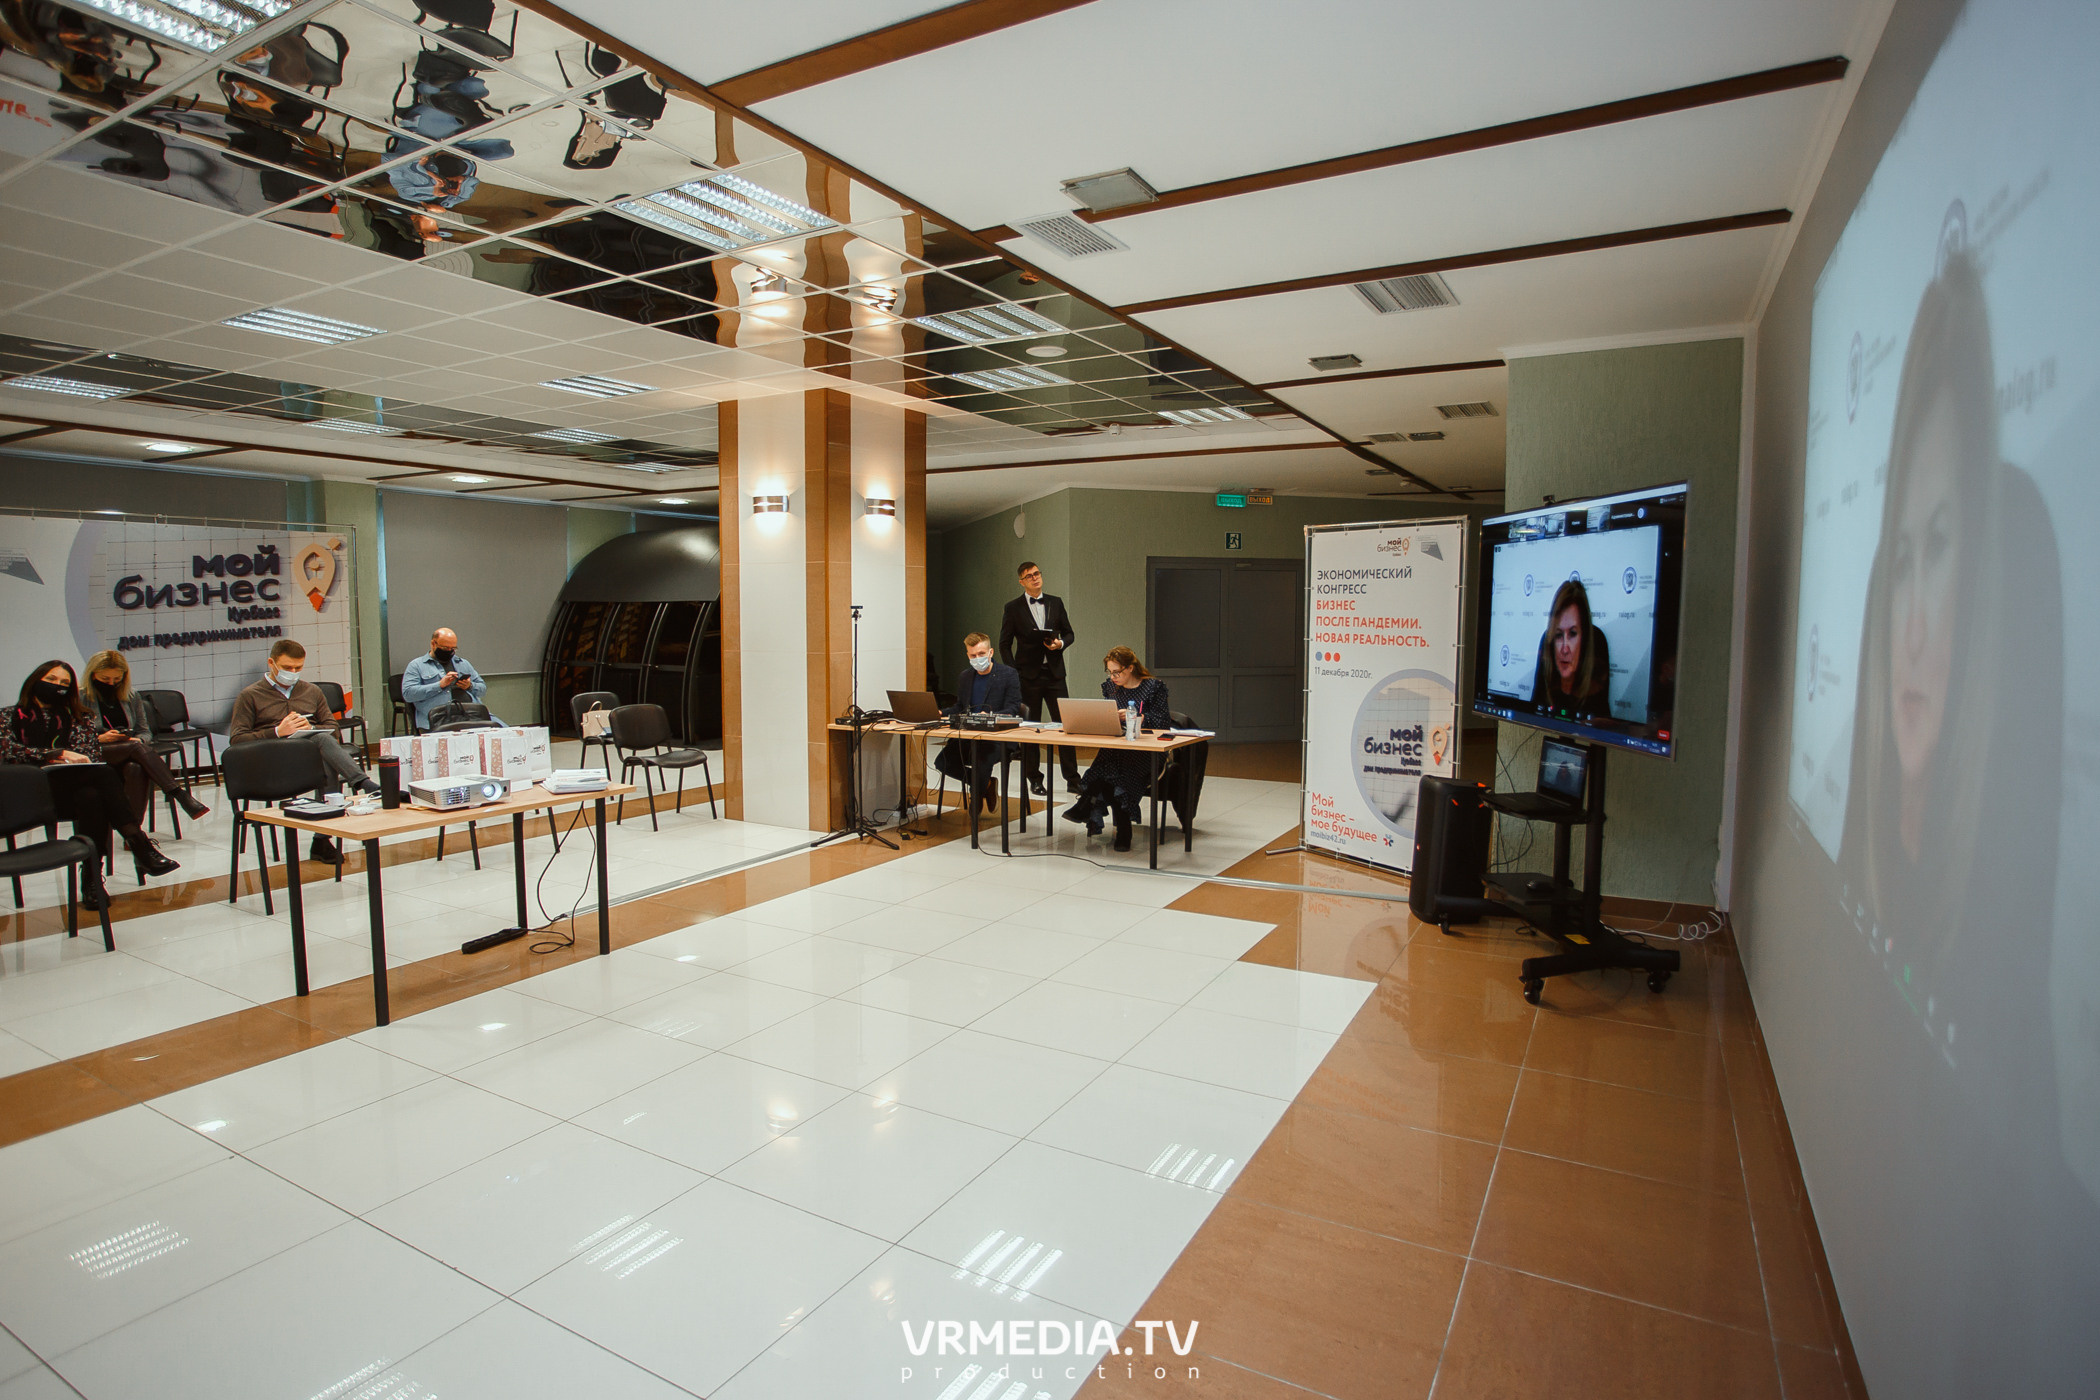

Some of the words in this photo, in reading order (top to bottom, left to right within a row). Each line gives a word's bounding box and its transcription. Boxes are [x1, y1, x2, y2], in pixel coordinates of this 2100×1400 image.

[192, 544, 281, 578] мой
[1317, 566, 1412, 580] ЭКОНОМИЧЕСКИЙ
[113, 574, 280, 610] бизнес
[1317, 584, 1367, 594] КОНГРЕСС
[1316, 600, 1355, 611] БИЗНЕС
[1316, 616, 1351, 627] ПОСЛЕ
[1352, 617, 1422, 629] ПАНДЕМИИ.
[117, 635, 150, 651] дом
[153, 625, 282, 649] предпринимателя
[1315, 632, 1350, 644] НОВАЯ
[1352, 634, 1430, 647] РЕАЛЬНОСТЬ.
[1315, 666, 1320, 675] 11
[1321, 668, 1349, 678] декабря
[1390, 724, 1423, 742] мой
[1364, 736, 1423, 757] бизнес
[1311, 792, 1334, 808] Мой
[1311, 804, 1346, 822] бизнес
[1310, 819, 1330, 830] мое
[1331, 821, 1378, 842] будущее
[1310, 830, 1347, 845] moibiz42.ru
